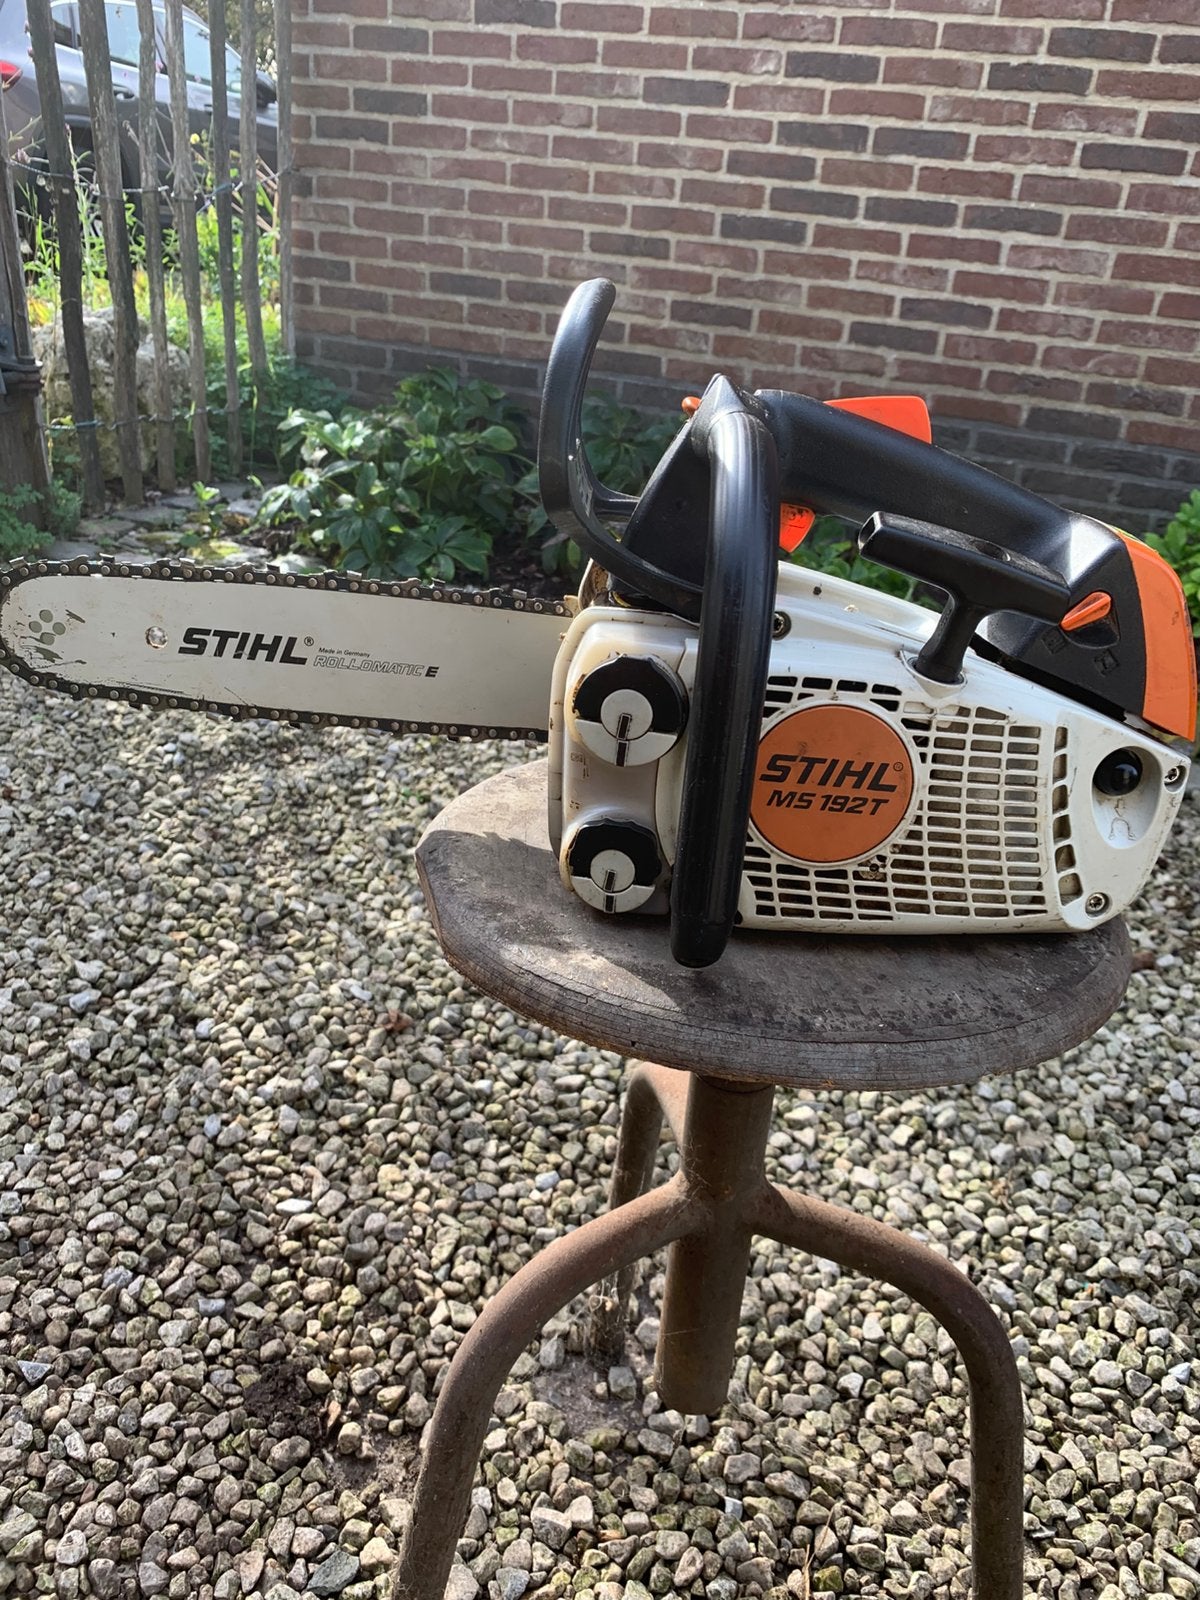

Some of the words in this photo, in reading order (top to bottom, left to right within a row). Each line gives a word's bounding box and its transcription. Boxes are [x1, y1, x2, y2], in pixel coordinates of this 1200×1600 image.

[318, 647, 335, 655] Made
[344, 649, 370, 658] Germany
[313, 655, 424, 676] ROLLOMATIC
[425, 666, 439, 677] E
[766, 790, 816, 810] MS
[820, 794, 890, 816] 192T
